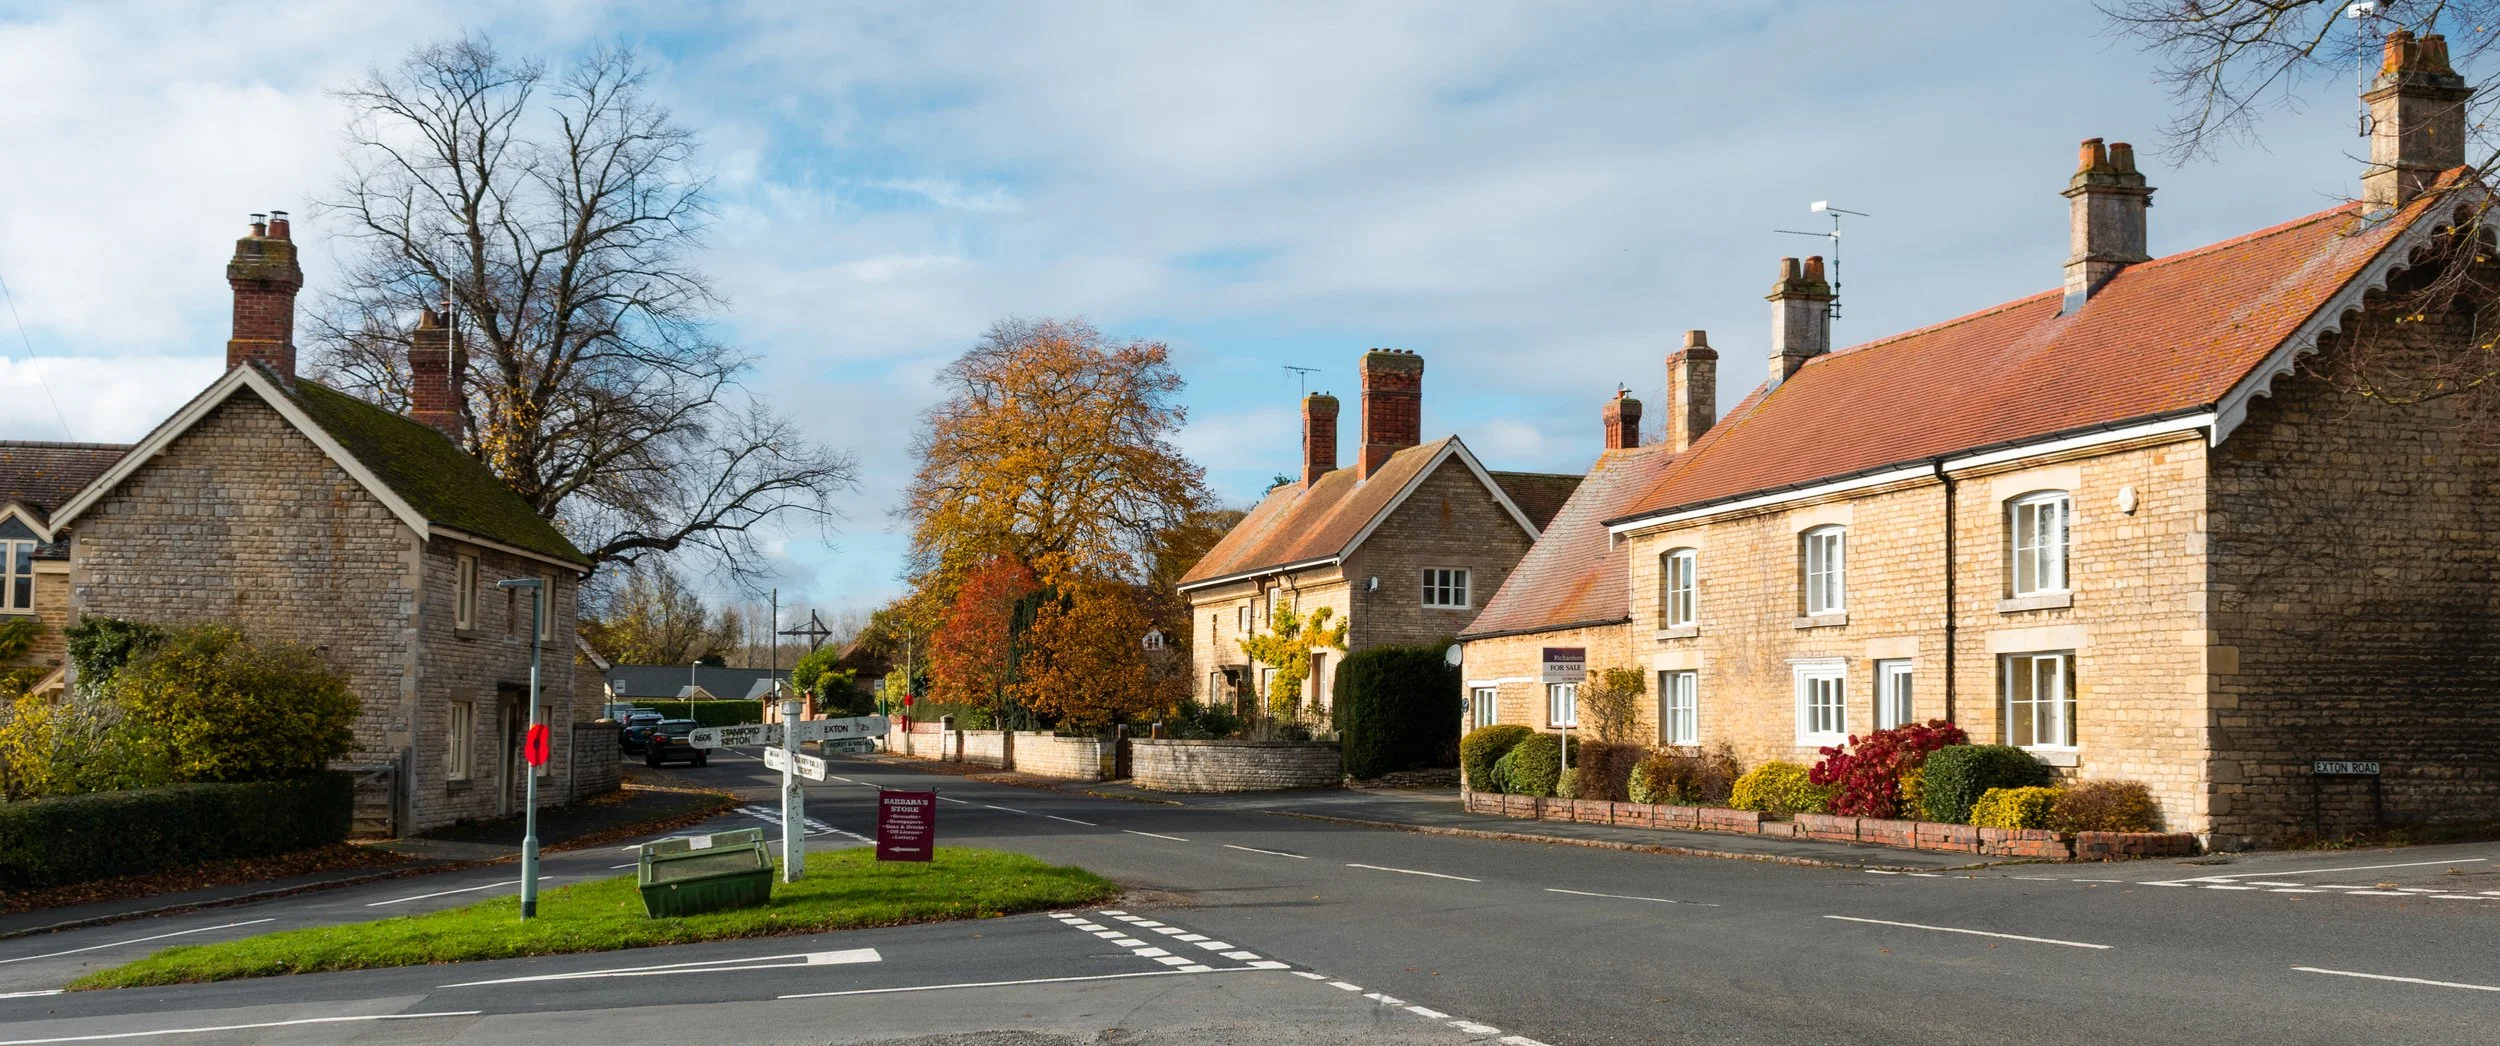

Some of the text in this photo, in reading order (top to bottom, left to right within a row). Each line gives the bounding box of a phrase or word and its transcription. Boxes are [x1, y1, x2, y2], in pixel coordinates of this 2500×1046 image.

[721, 727, 759, 737] STAMFORD
[824, 725, 848, 733] EXTON
[694, 733, 712, 742] A606
[721, 737, 750, 746] KETTON
[2316, 762, 2377, 773] EXTON ROAD
[884, 798, 929, 806] BARBARA'S
